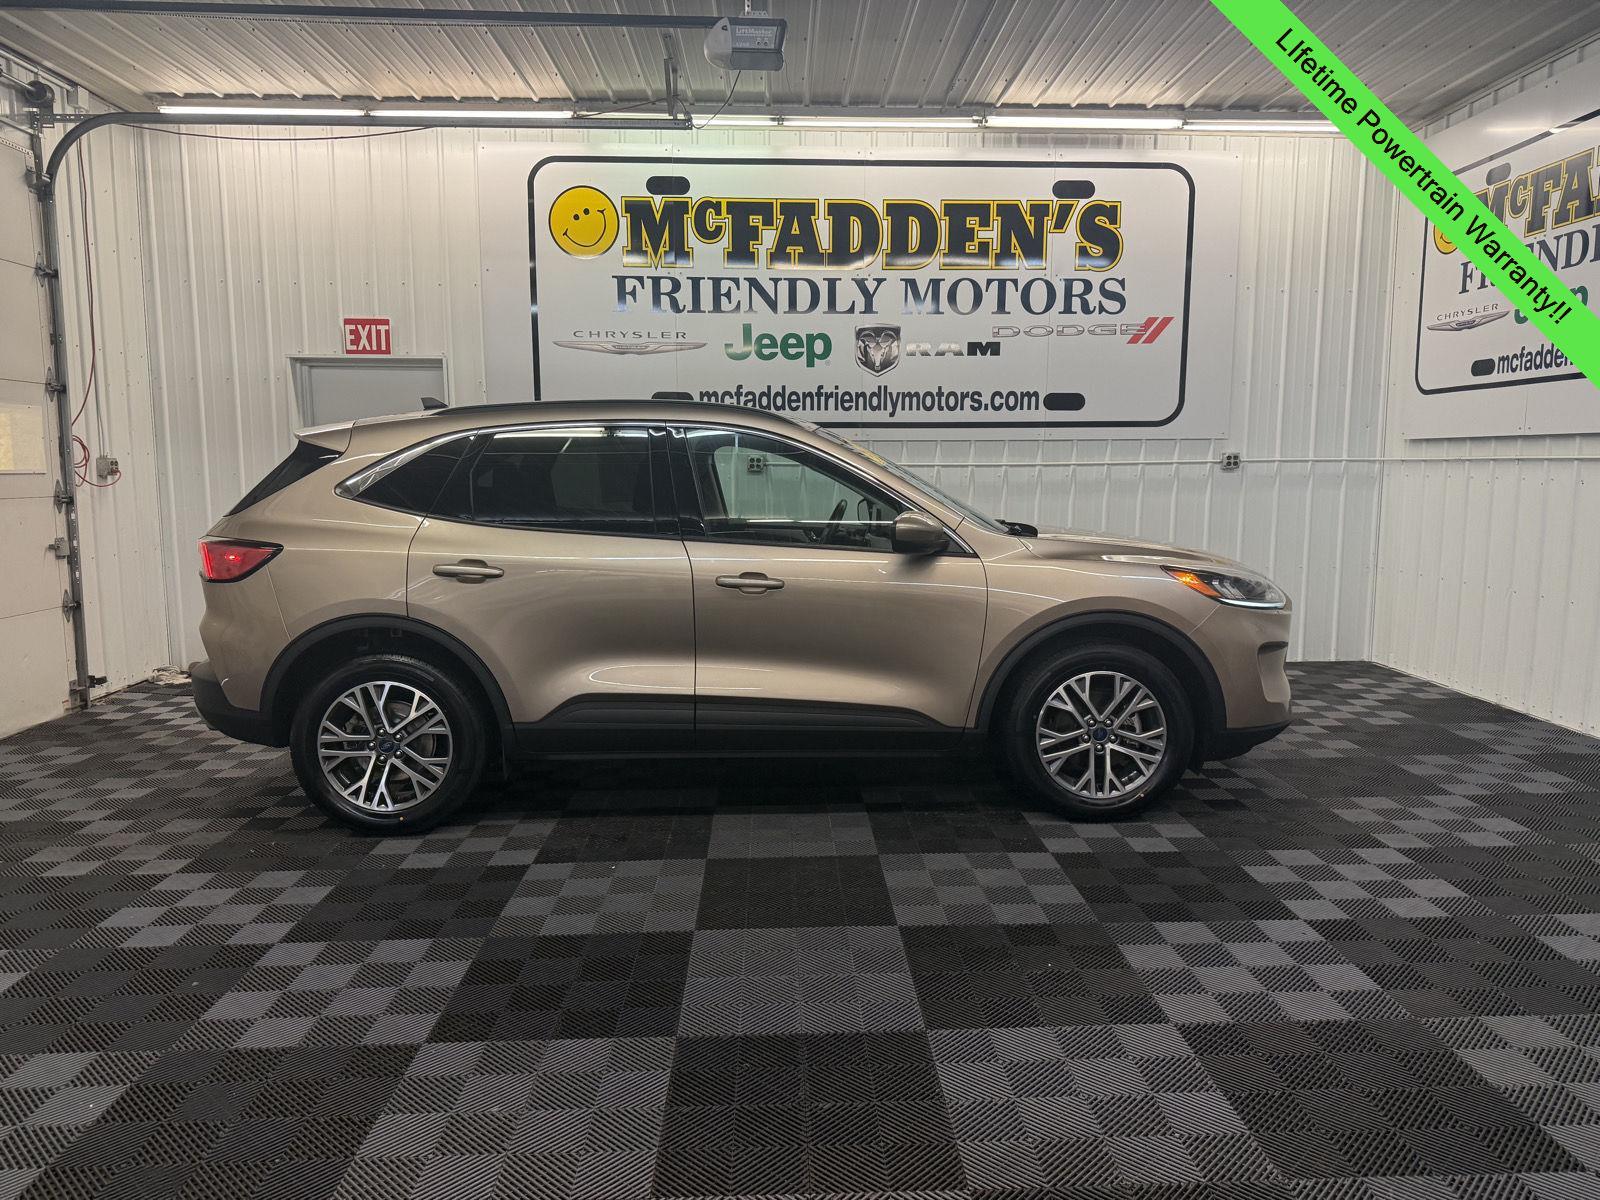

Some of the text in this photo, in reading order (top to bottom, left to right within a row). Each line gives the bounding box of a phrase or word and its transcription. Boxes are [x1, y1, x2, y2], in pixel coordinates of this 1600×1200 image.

[612, 274, 1127, 316] FRIENDLY MOTORS
[1436, 303, 1499, 322] CHRYSLER
[344, 324, 389, 351] EXIT
[572, 330, 688, 340] CHRYSLER
[991, 323, 1147, 338] DODGE
[724, 323, 833, 367] Jeep
[905, 341, 1001, 357] RAM
